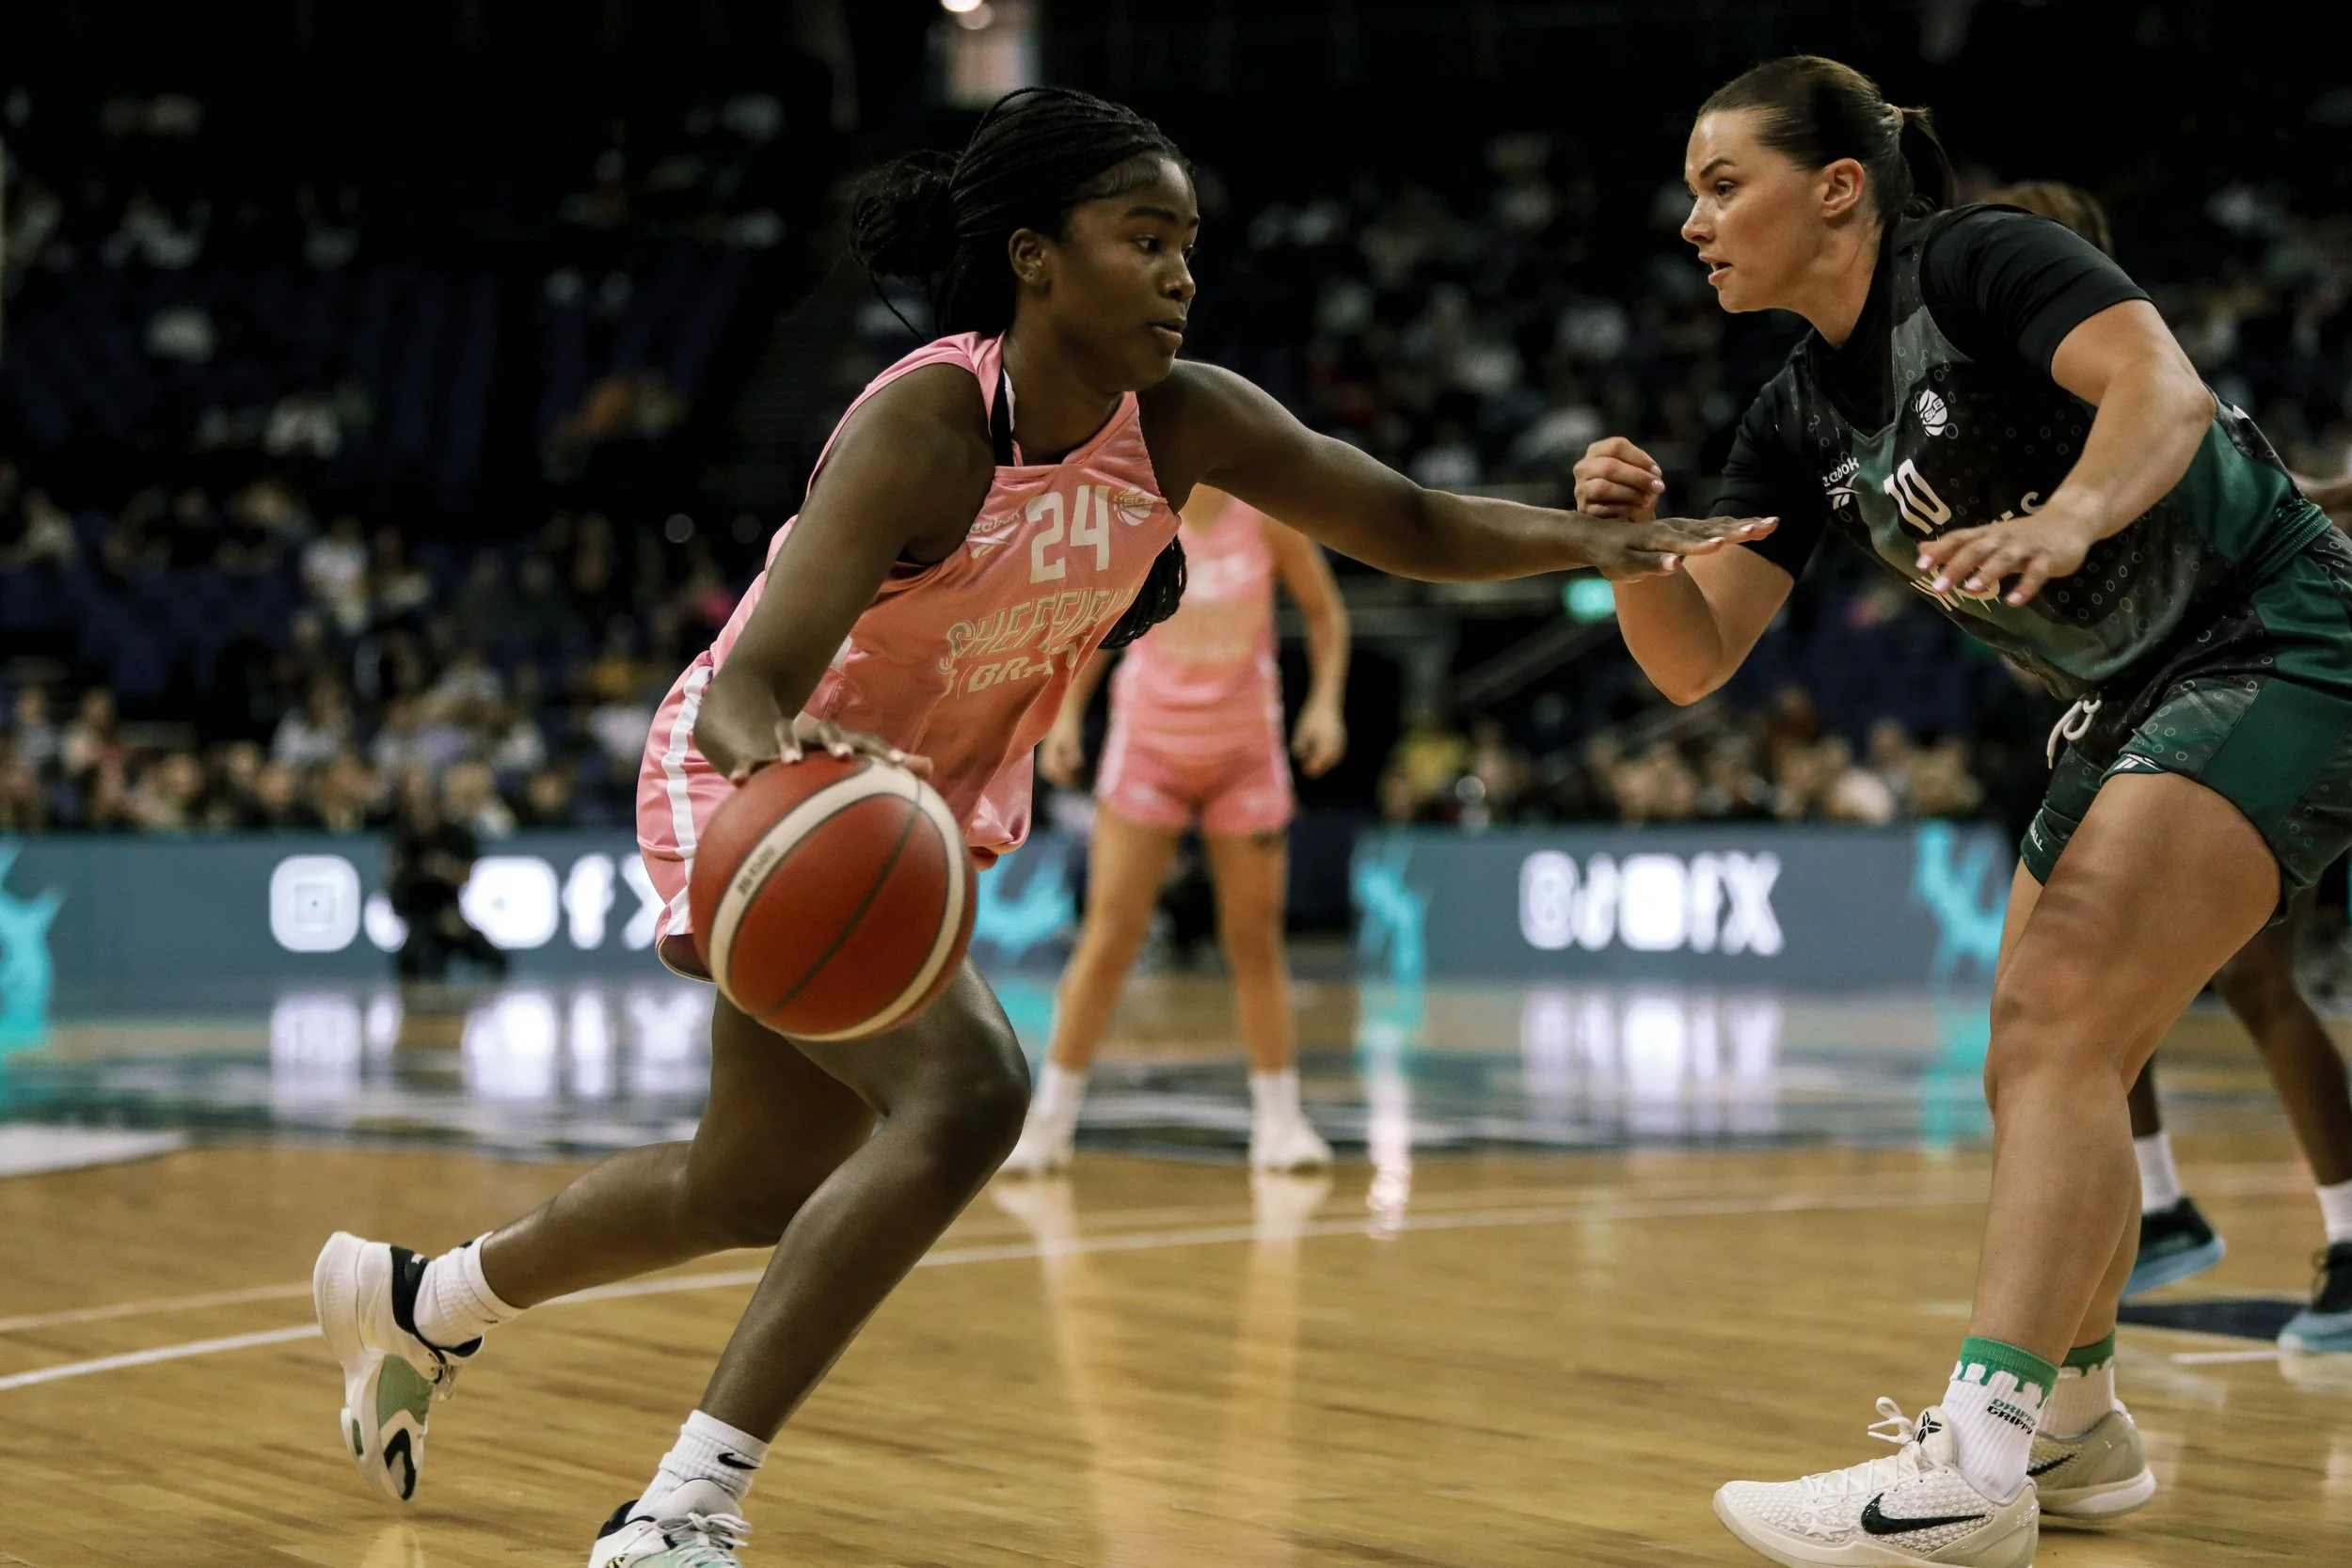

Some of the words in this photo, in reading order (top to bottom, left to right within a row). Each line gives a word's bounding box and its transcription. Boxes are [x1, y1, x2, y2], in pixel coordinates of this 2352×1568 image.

[1923, 398, 1946, 422] SLB
[1883, 458, 1951, 534] 10
[1025, 484, 1111, 583] 24
[1987, 1406, 2033, 1434] GRIPPY
